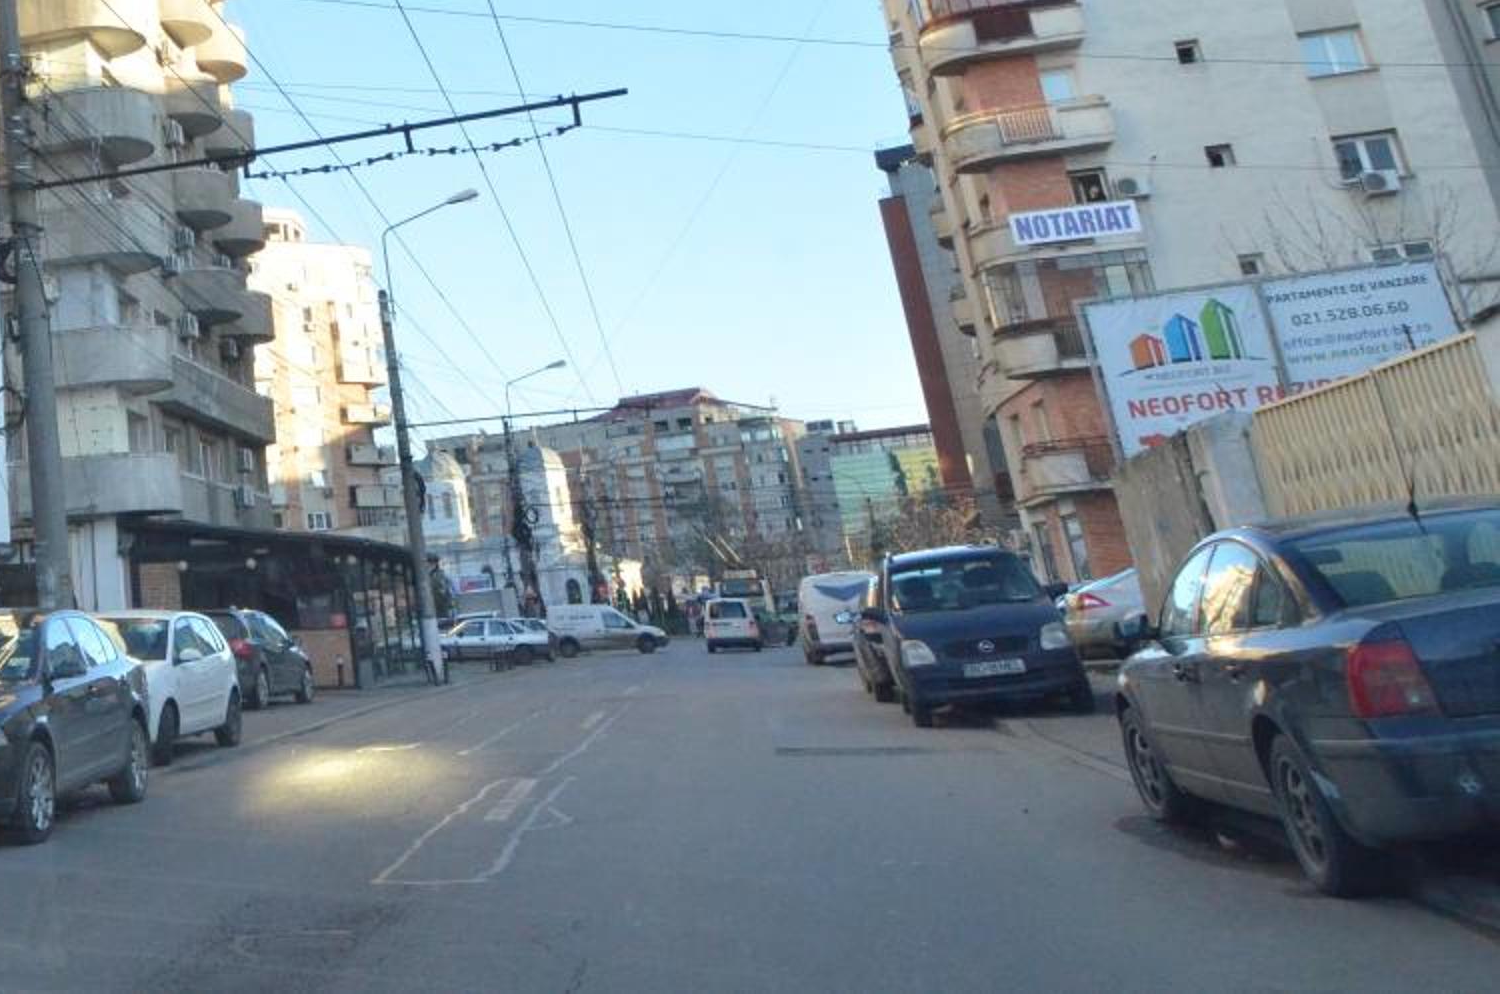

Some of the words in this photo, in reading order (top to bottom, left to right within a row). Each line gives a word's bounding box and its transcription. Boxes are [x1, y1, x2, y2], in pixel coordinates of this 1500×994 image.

[1014, 205, 1133, 241] NOTARIAT
[1264, 285, 1348, 304] PARTAMENTE
[1350, 283, 1365, 294] DE
[1127, 387, 1247, 419] NEOFORT
